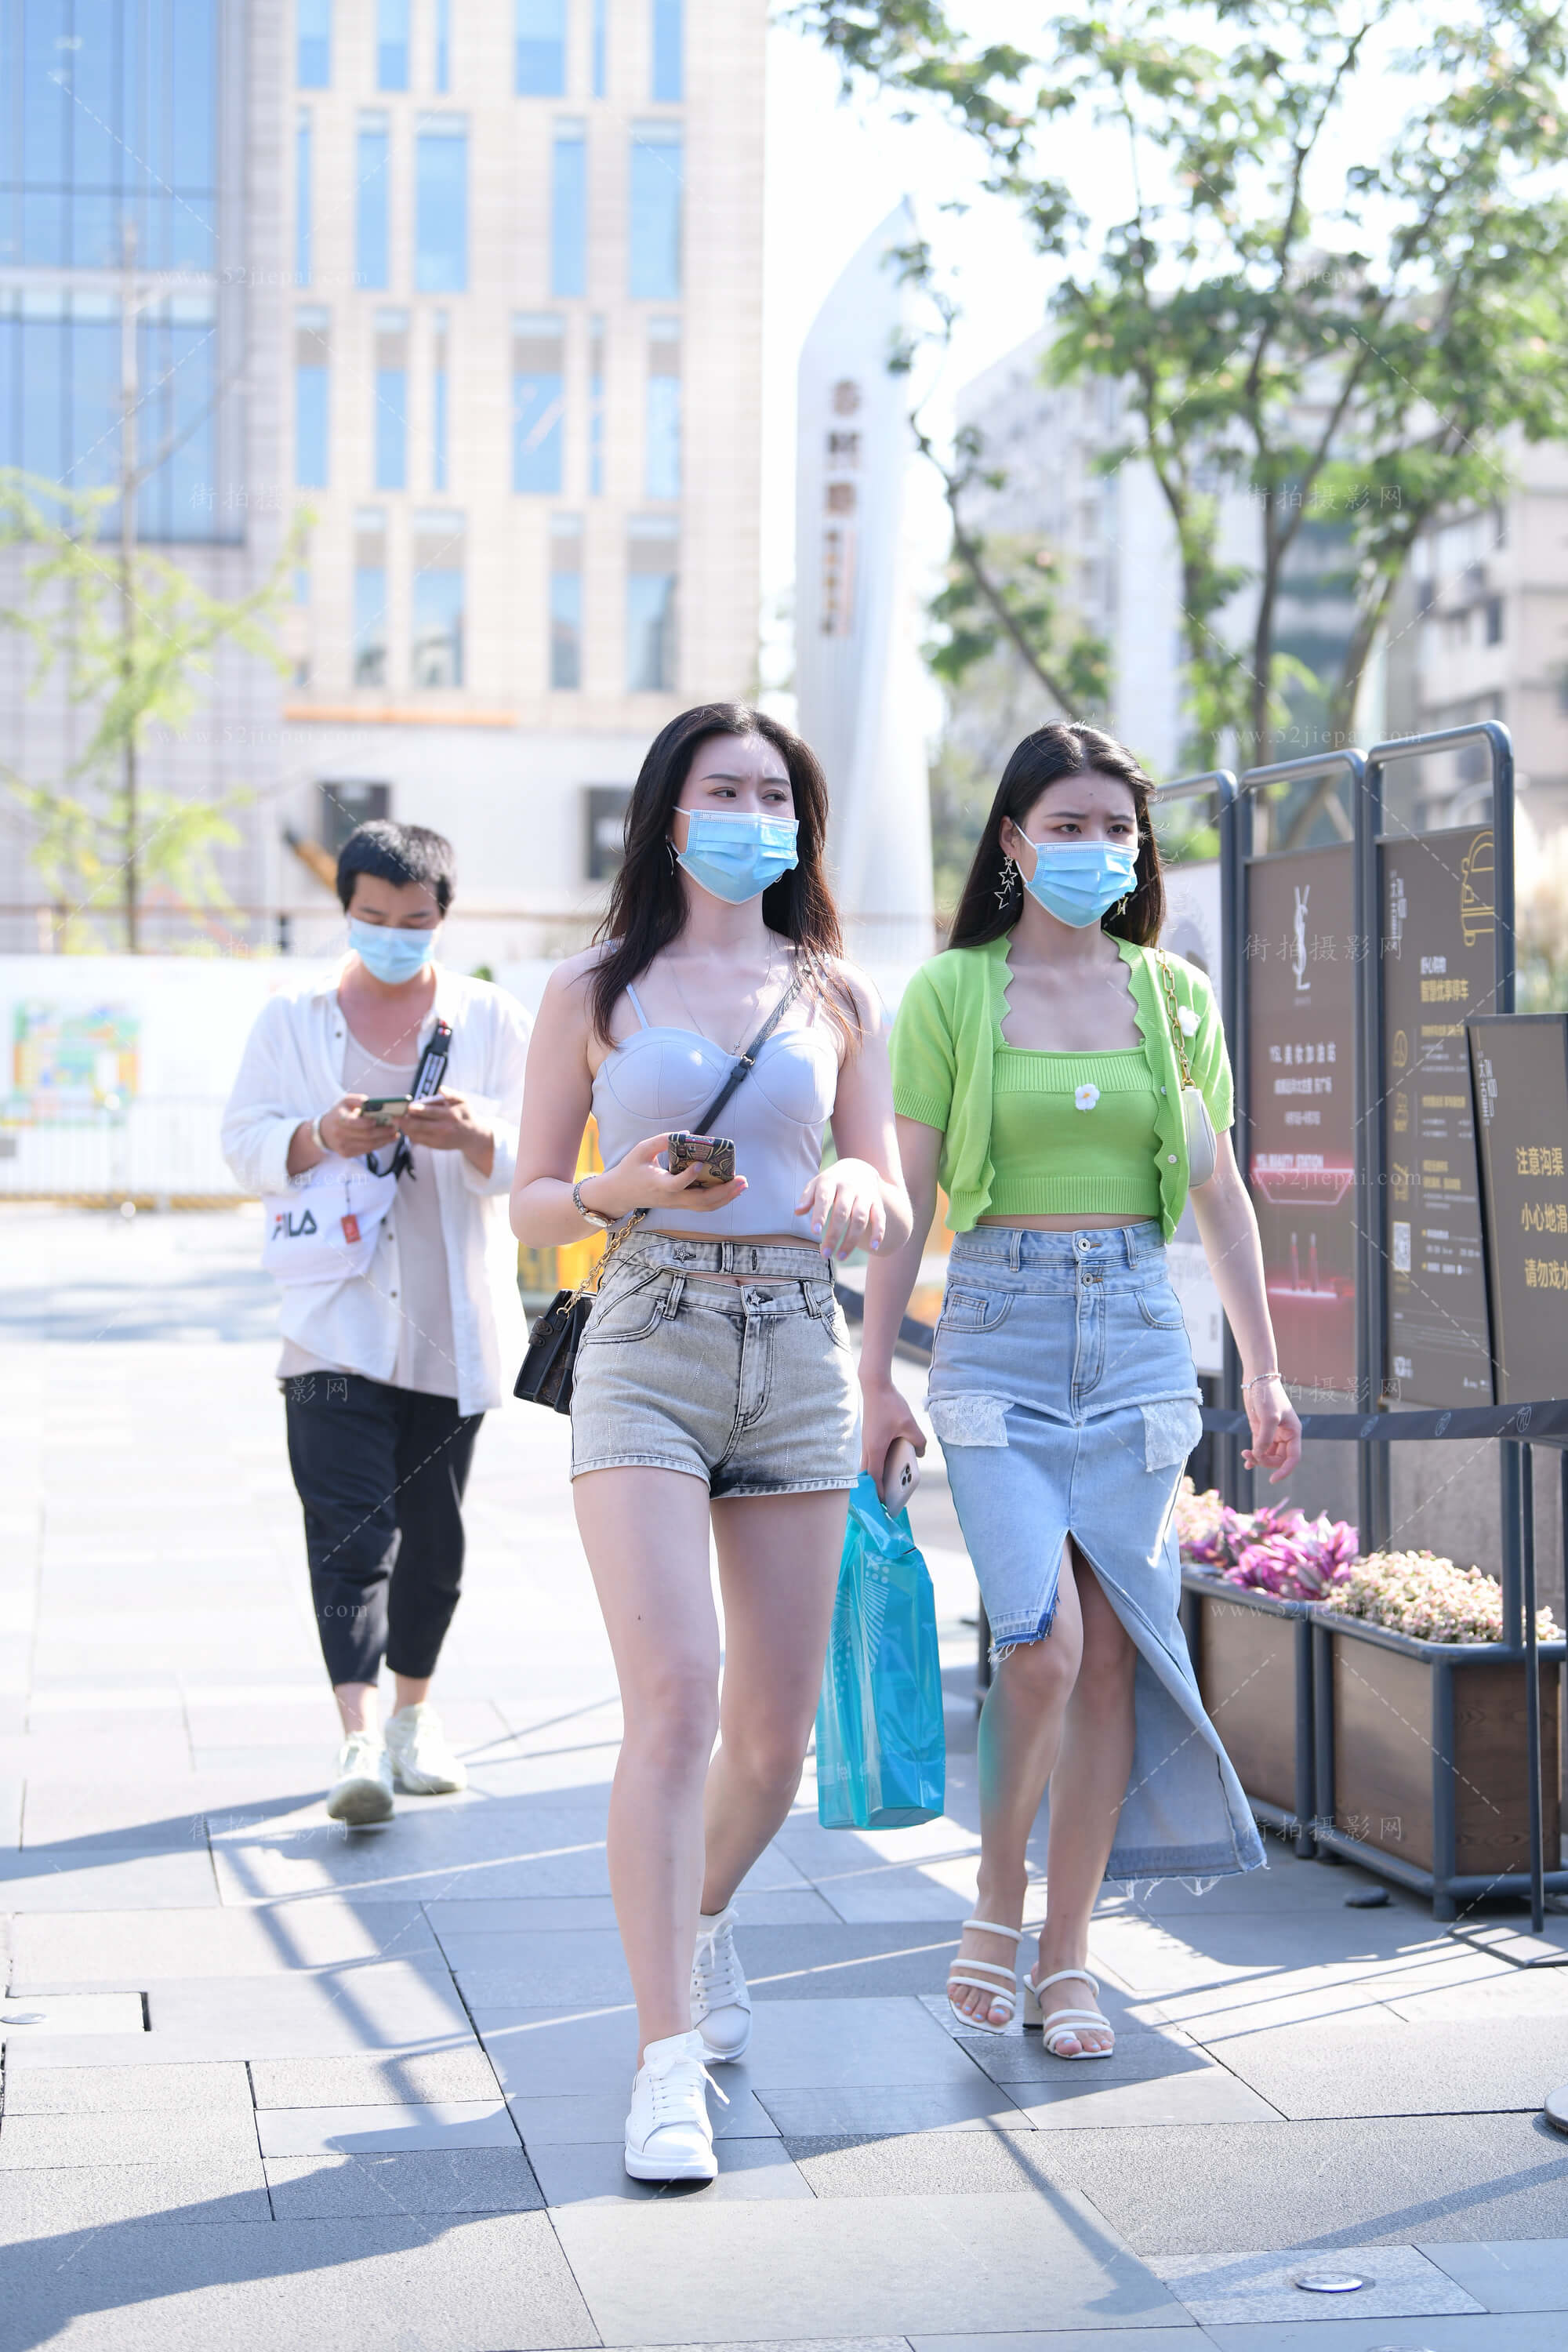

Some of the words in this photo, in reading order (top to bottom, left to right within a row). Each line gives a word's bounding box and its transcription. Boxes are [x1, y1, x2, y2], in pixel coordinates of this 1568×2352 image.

[1515, 1146, 1565, 1177] 注意沟渠
[1521, 1202, 1568, 1234] 小心地滑
